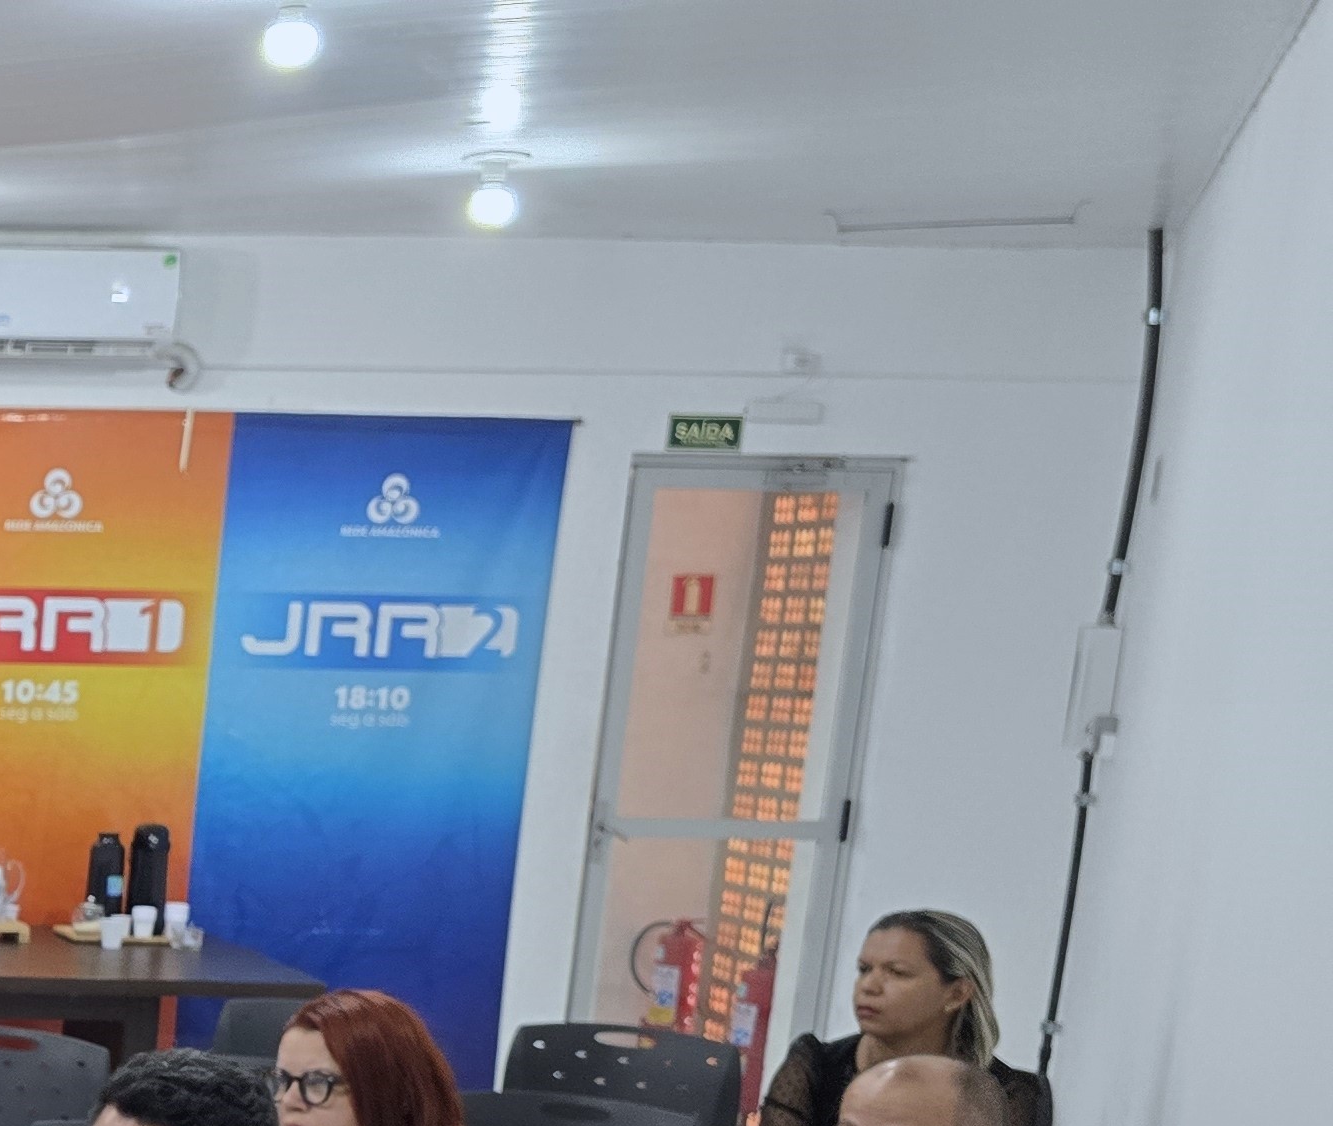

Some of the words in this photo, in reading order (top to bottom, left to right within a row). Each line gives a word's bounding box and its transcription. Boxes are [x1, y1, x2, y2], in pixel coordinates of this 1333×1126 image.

[674, 419, 734, 441] SAÍDA
[0, 678, 80, 704] 10:45
[334, 684, 411, 711] 18:10
